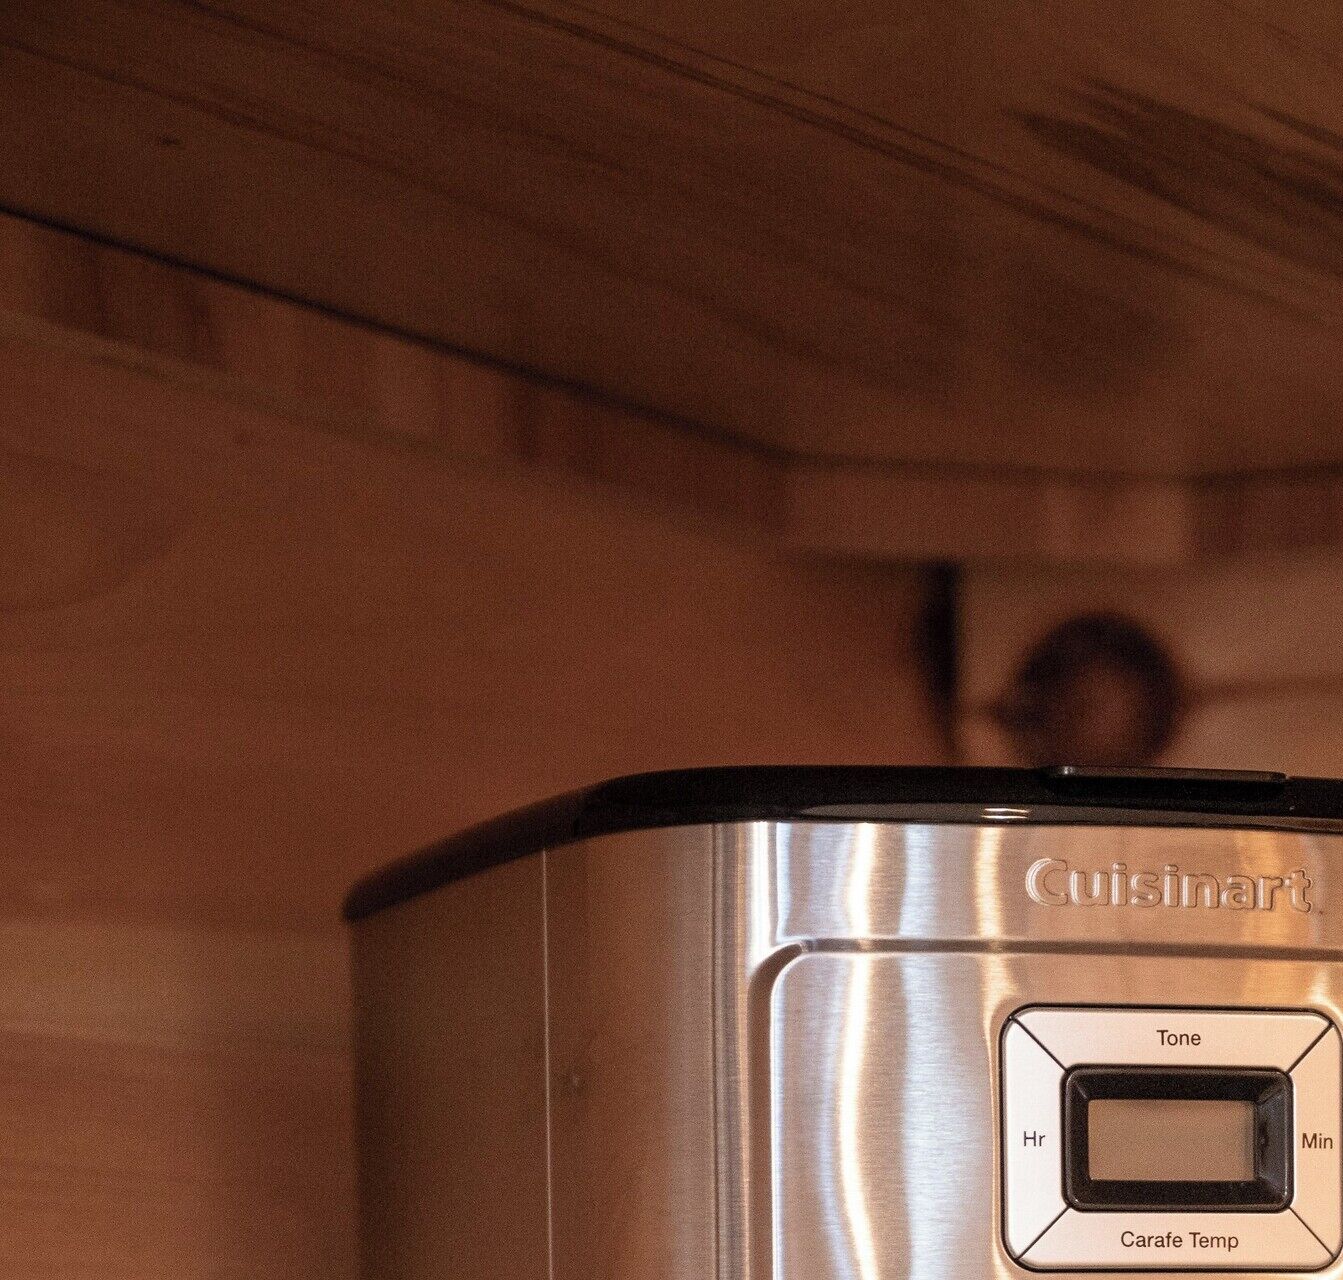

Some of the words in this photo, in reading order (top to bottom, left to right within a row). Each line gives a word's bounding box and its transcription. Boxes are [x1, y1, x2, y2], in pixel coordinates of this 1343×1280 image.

[1025, 858, 1312, 913] Cuisinart
[1157, 1029, 1202, 1046] Tone
[1023, 1131, 1046, 1147] Hr
[1301, 1133, 1334, 1150] Min
[1120, 1231, 1183, 1248] Carafe
[1189, 1232, 1240, 1251] Temp
